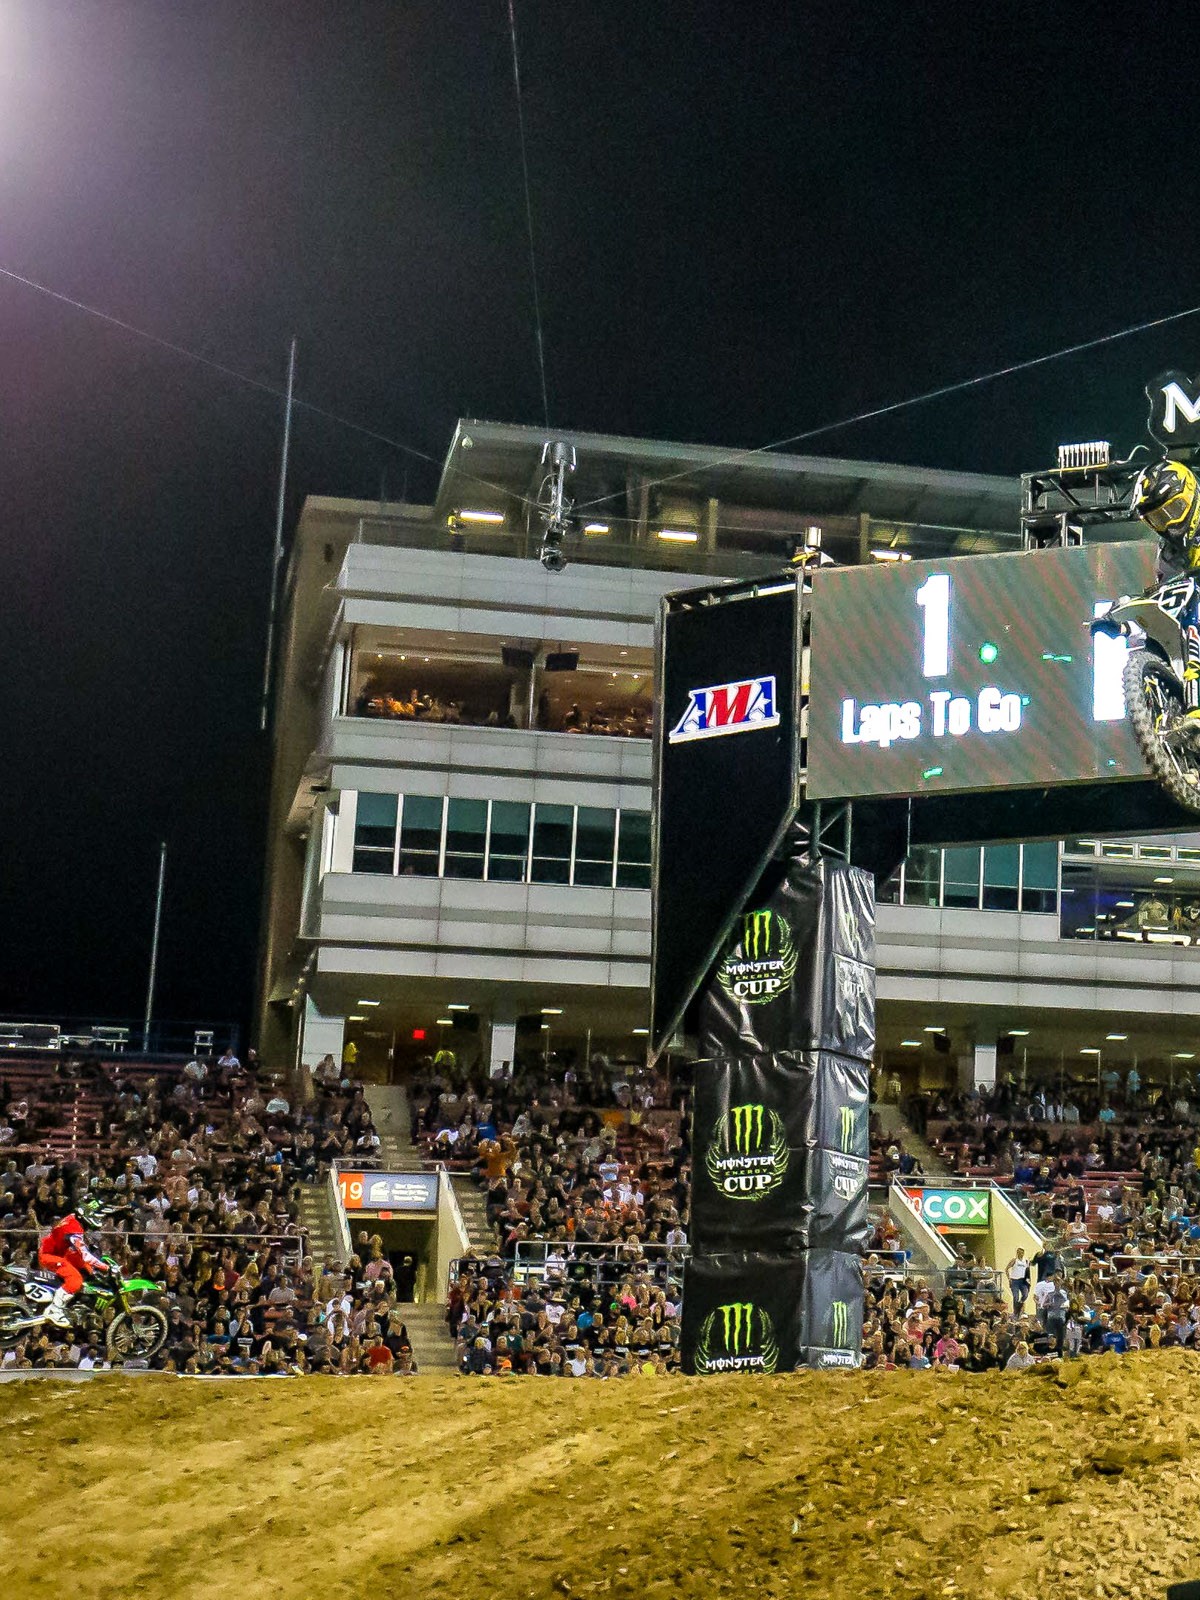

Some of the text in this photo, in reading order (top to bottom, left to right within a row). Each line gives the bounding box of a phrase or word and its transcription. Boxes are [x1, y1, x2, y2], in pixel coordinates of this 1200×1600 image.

[916, 573, 952, 678] 1
[673, 678, 777, 736] AMA
[842, 687, 1021, 747] Laps To Go
[726, 960, 785, 976] MONSTER
[733, 978, 782, 997] CUP
[716, 1155, 777, 1171] MONSTER
[340, 1182, 363, 1200] 19
[723, 1174, 772, 1193] CUP
[923, 1195, 988, 1220] COX
[705, 1355, 766, 1370] MONSTER
